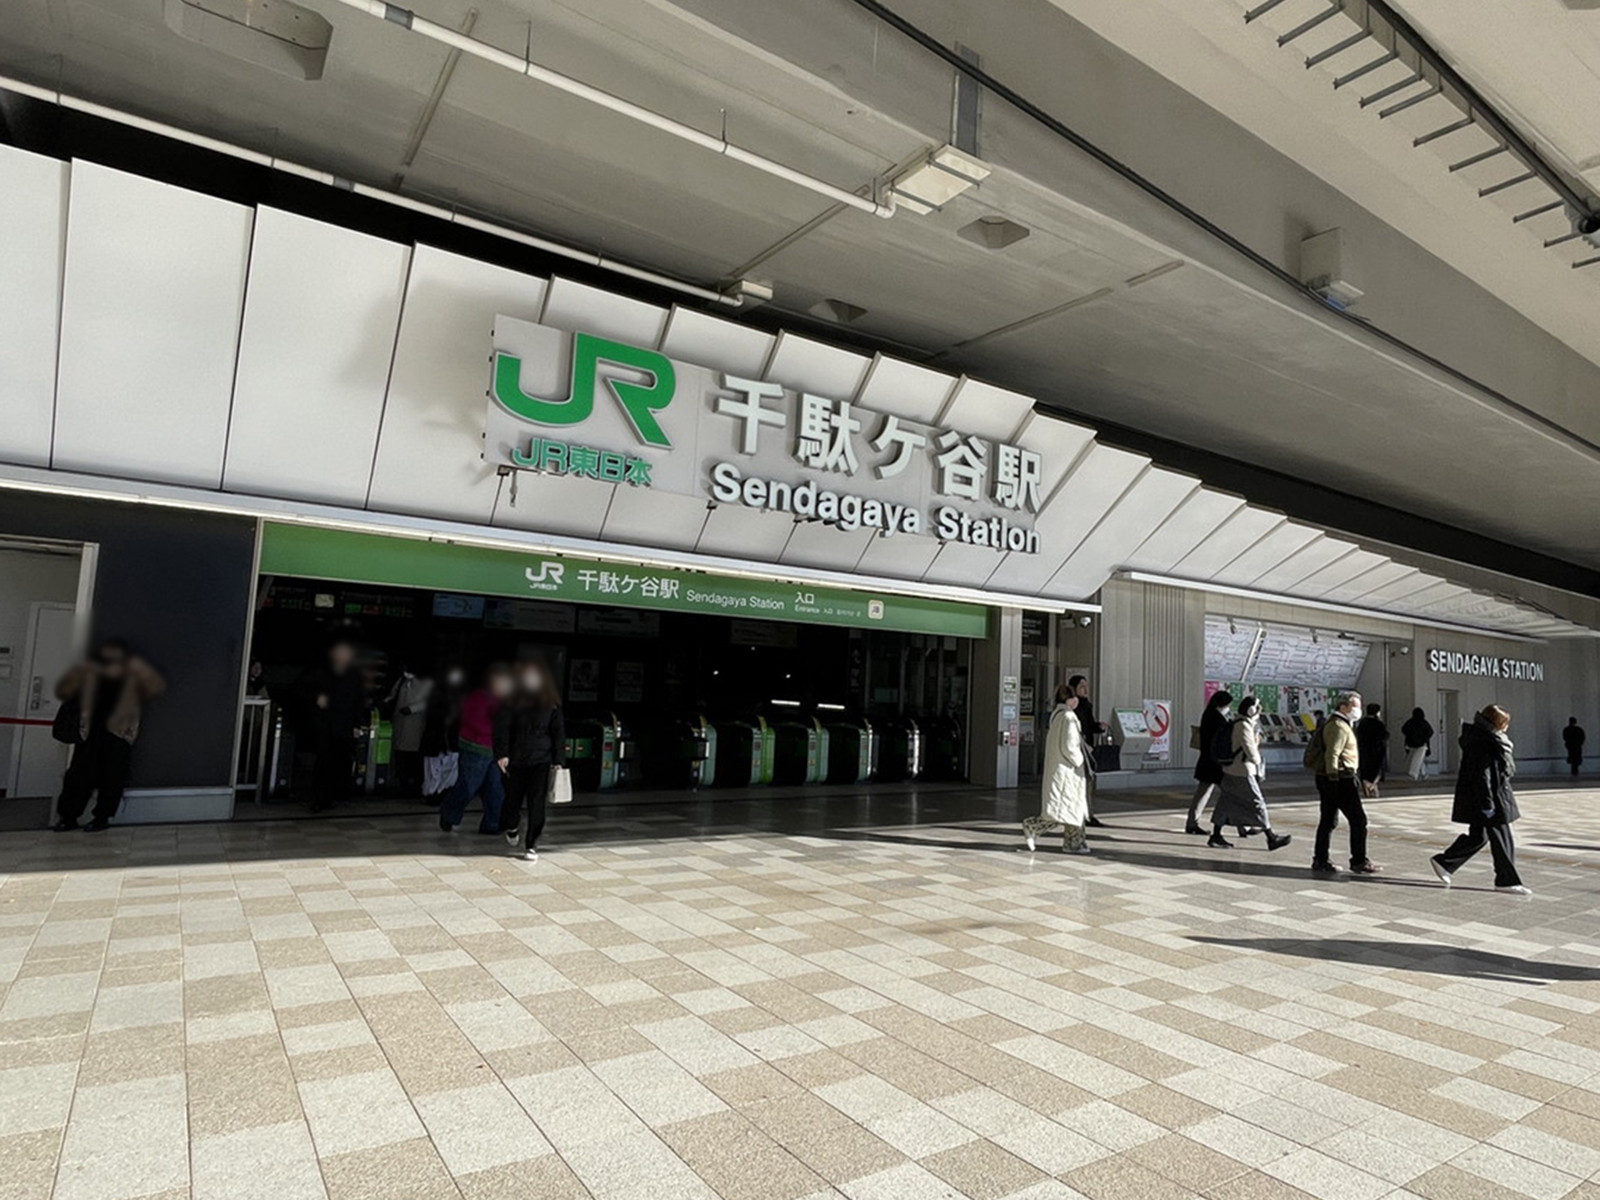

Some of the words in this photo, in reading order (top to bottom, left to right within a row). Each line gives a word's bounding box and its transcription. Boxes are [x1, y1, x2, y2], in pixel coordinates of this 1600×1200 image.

[494, 331, 677, 449] JR
[512, 437, 653, 486] JR東日本
[713, 373, 1041, 514] 千駄ケ谷駅
[711, 462, 921, 538] Sendagaya
[938, 506, 1041, 554] Station
[525, 561, 565, 585] JR
[577, 569, 680, 600] 千駄ケ谷駅
[686, 589, 747, 608] Sendagaya
[749, 595, 785, 610] Station
[794, 591, 815, 605] 入口
[1430, 649, 1500, 677] SENDAGAYA
[1501, 659, 1544, 681] STATION
